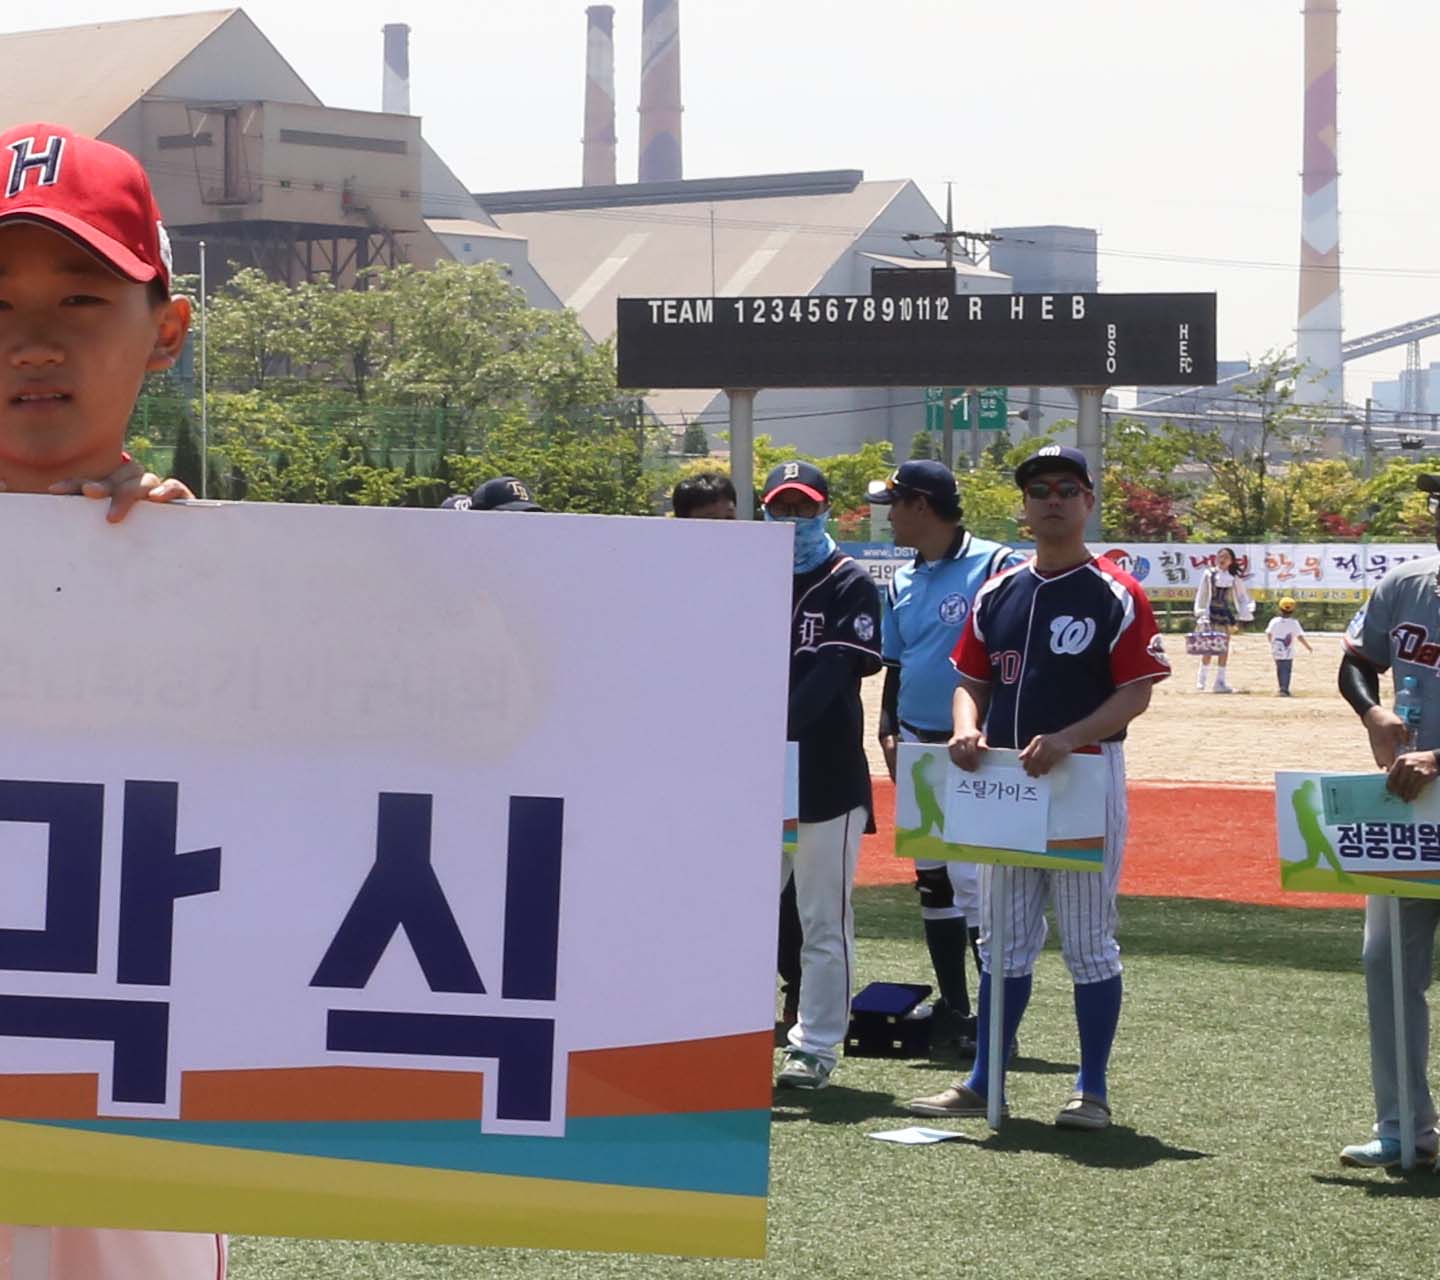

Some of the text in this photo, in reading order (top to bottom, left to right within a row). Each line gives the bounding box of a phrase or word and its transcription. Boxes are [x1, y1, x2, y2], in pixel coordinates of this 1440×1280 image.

[5, 135, 65, 198] H
[648, 295, 1085, 323] TEAM 1 2 3 4 5 6 7 8 9 10 11 12 R H E B
[1107, 324, 1117, 339] B
[1179, 324, 1189, 339] H
[1107, 341, 1116, 356] S
[1179, 341, 1188, 356] E
[1049, 615, 1096, 655] W
[955, 779, 1038, 803] 스틸가이즈
